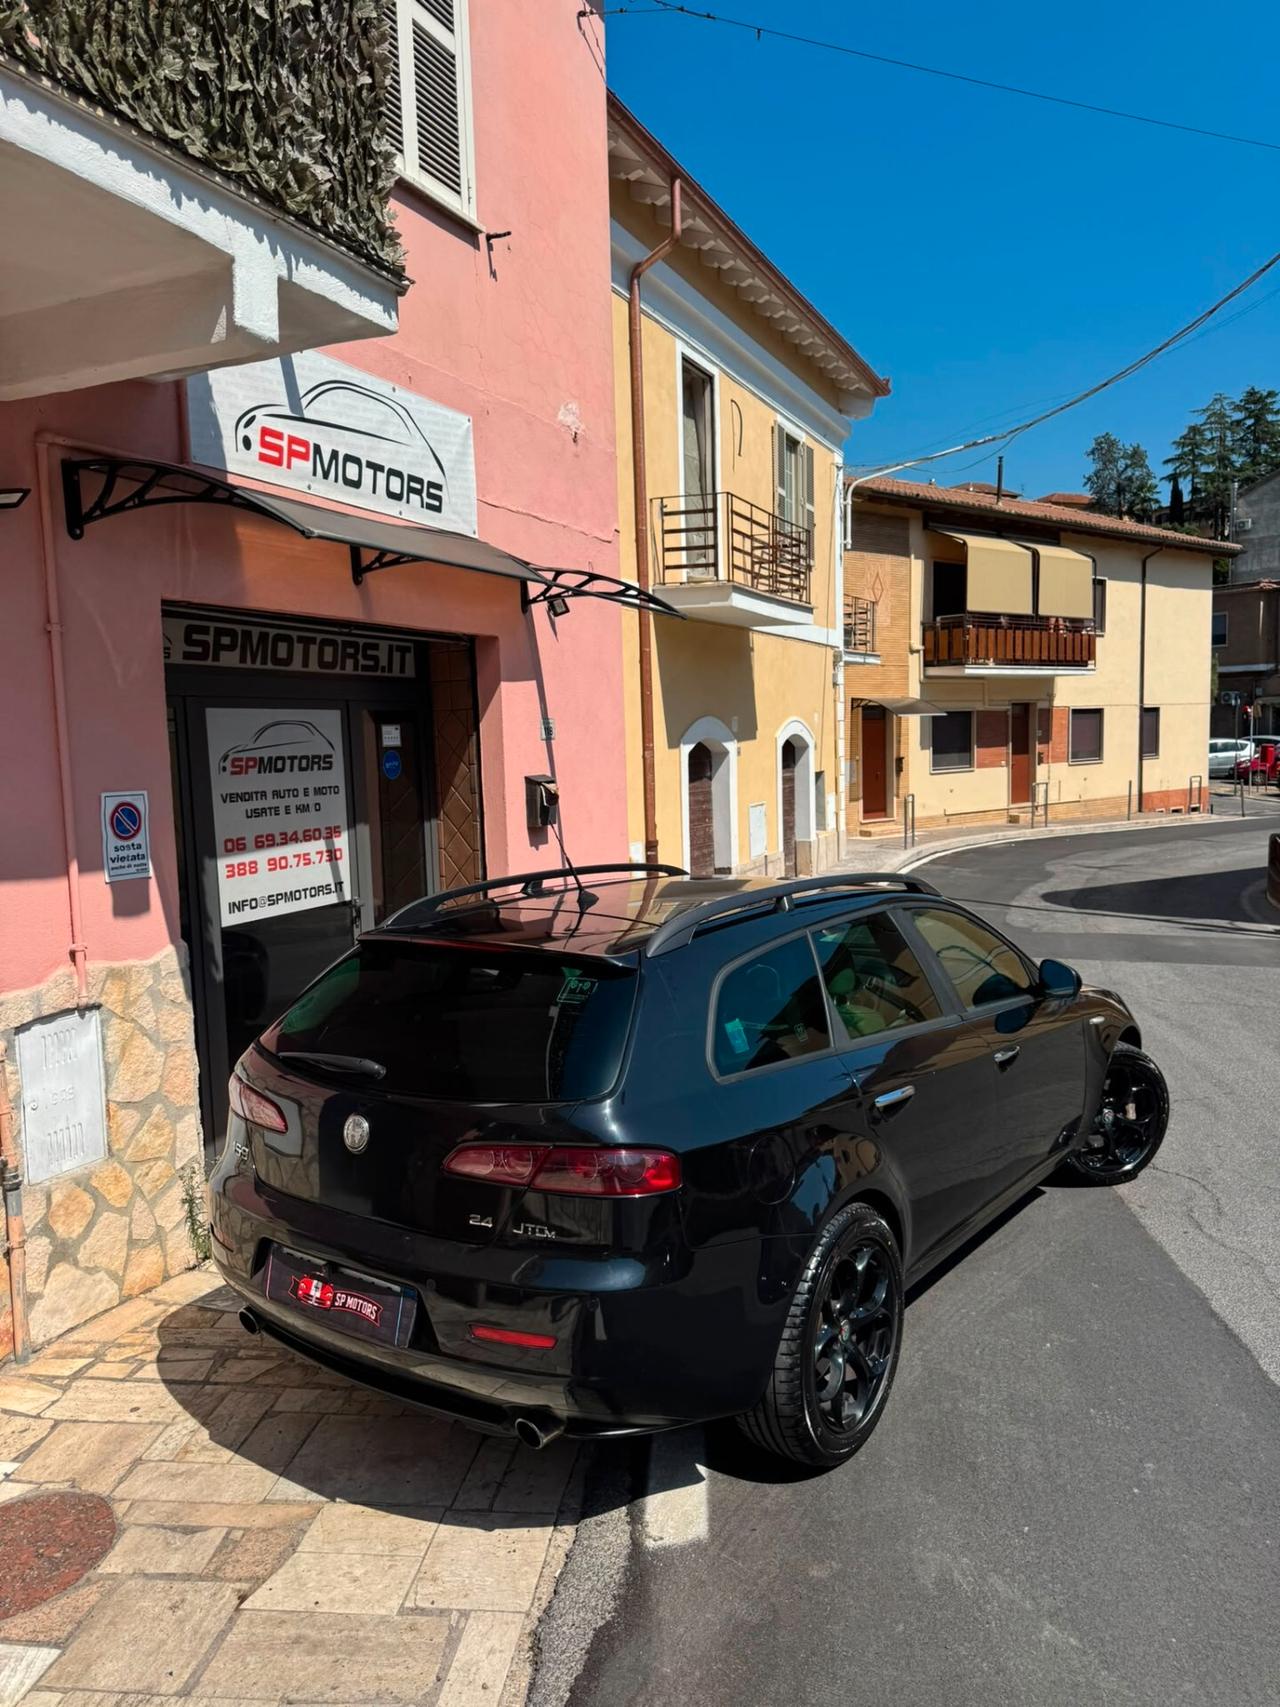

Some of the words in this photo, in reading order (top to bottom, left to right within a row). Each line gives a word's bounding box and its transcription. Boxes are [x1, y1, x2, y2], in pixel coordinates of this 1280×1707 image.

[258, 426, 443, 514] SPMOTORS
[182, 624, 412, 674] SPMOTORS.IT
[230, 754, 334, 776] SPMOTORS
[220, 790, 268, 804] VENDITA
[271, 788, 299, 800] AUTO
[303, 787, 309, 797] E
[313, 785, 340, 796] MOTO
[245, 806, 280, 819] USATE
[285, 805, 291, 815] E
[295, 803, 310, 814] KM
[114, 843, 142, 852] sosta
[223, 836, 247, 853] 06
[254, 825, 342, 850] 69.34.60.35
[110, 853, 146, 863] vietata
[225, 860, 259, 879] 388
[267, 848, 343, 872] 90.75.730
[228, 881, 345, 915] INFO@SPMOTORS.IT
[334, 1293, 346, 1307] SP
[345, 1295, 378, 1320] MOTORS
